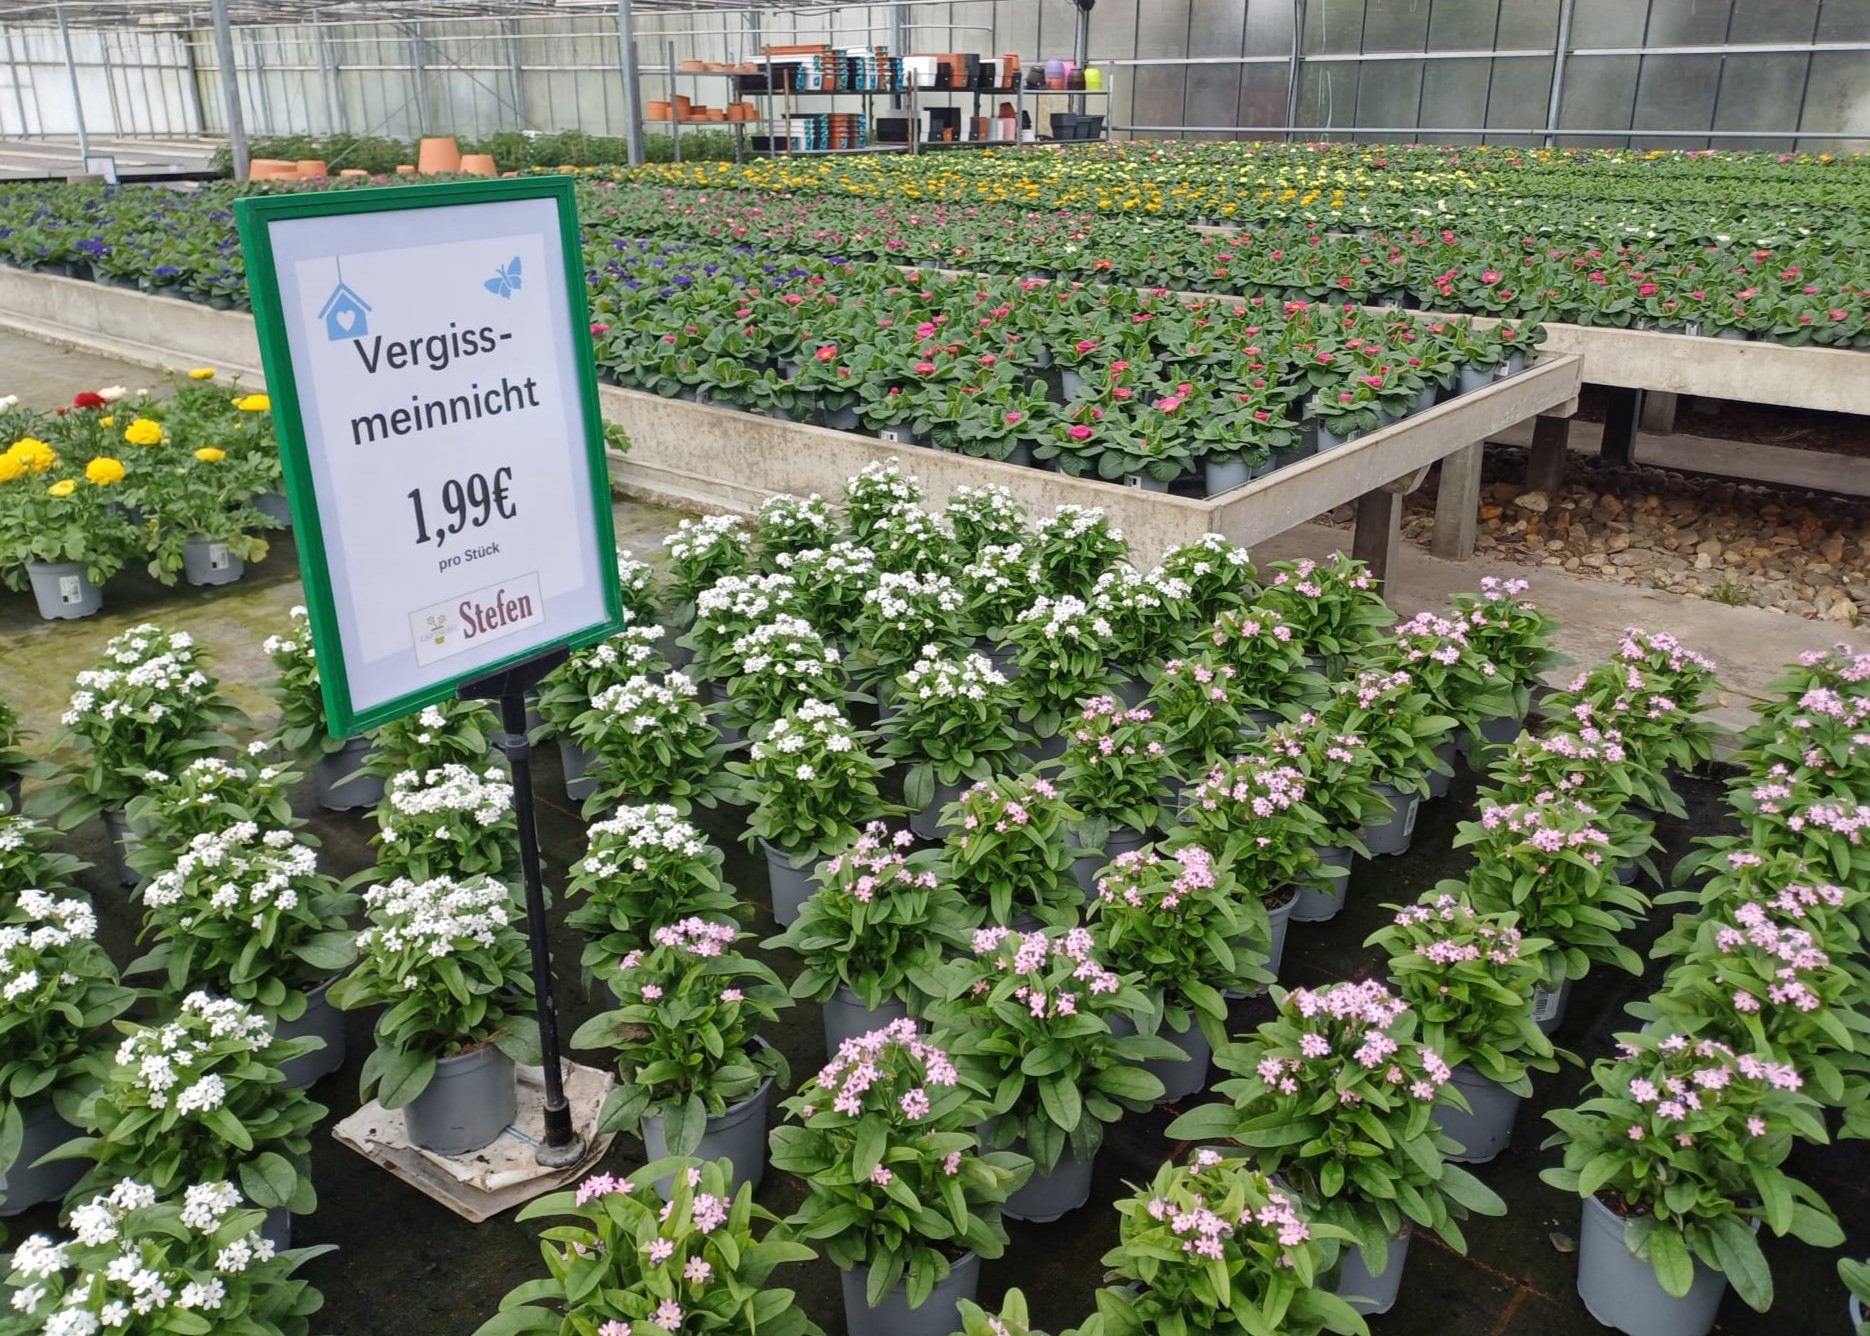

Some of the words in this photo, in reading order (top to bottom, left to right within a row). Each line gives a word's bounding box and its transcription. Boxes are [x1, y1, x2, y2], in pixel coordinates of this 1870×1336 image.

[354, 323, 513, 374] Vergiss-
[350, 378, 540, 446] meinnicht
[408, 467, 516, 548] 1,99€
[439, 556, 461, 573] pro
[465, 543, 500, 562] Stück
[459, 588, 533, 639] Stefen
